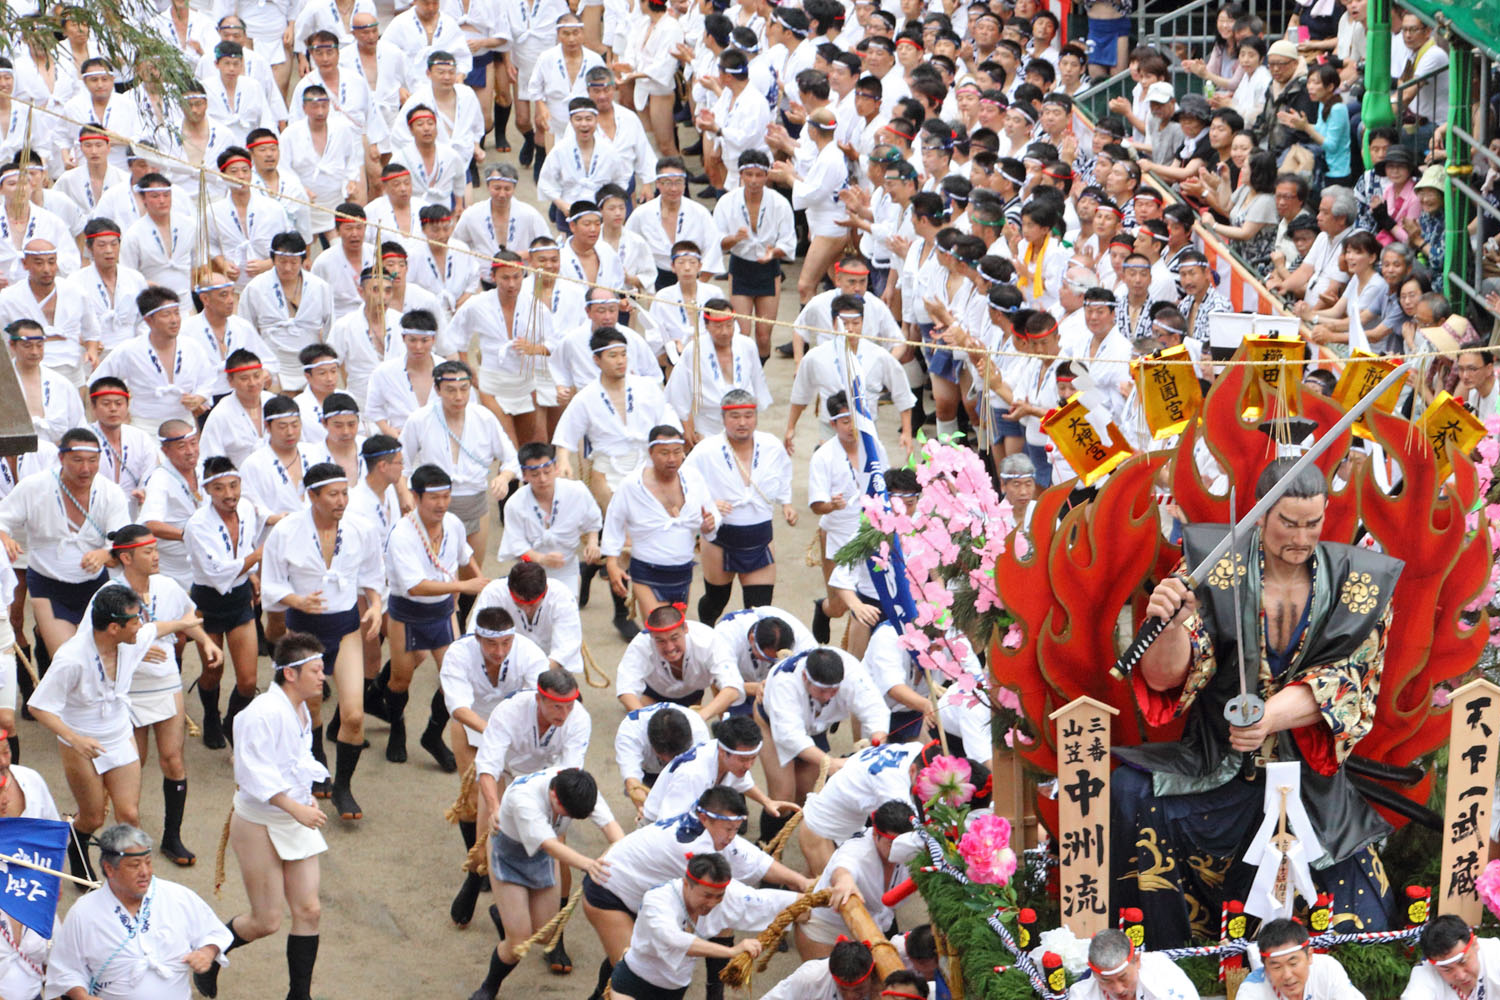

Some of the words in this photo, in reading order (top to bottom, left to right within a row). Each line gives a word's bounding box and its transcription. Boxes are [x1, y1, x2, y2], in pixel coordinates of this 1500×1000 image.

[1062, 719, 1084, 765] 山笠
[1087, 717, 1107, 763] 三番
[1062, 769, 1107, 917] 中洲流
[1447, 696, 1493, 902] 天下一武蔵
